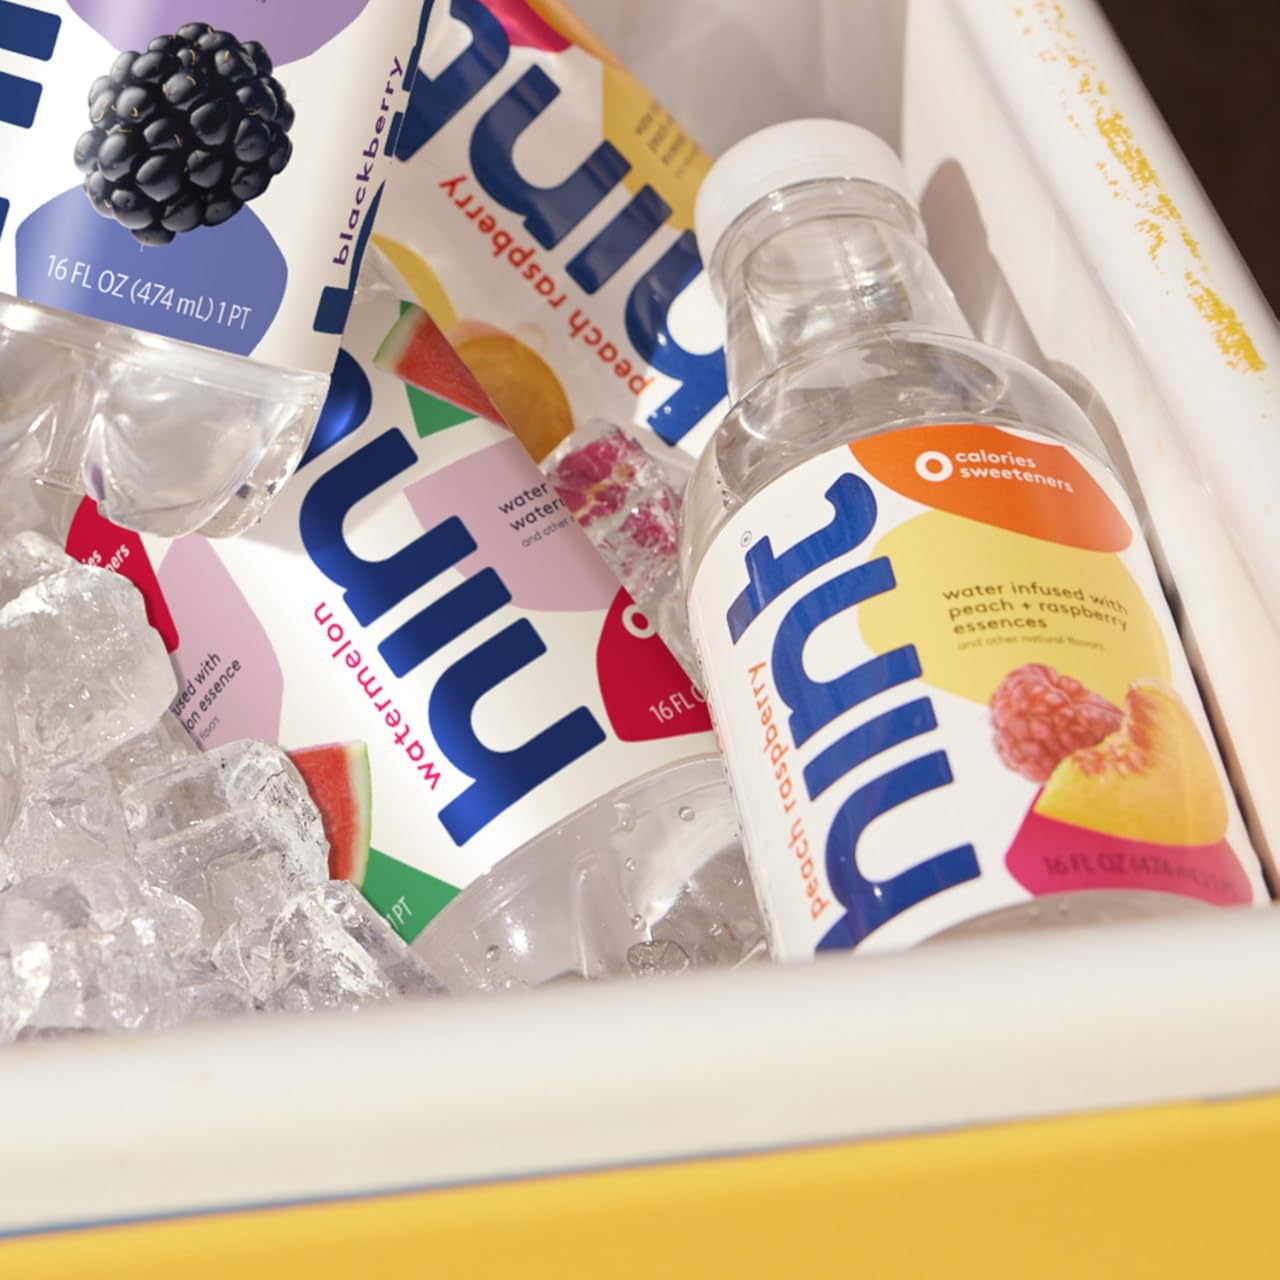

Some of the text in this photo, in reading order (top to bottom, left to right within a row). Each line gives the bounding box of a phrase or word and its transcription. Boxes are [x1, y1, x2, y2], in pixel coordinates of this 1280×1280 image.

[332, 56, 404, 267] blackberry
[47, 255, 253, 330] 16 FL OZ (474 mL) 1 PT
[438, 175, 655, 396] peach raspberry
[915, 449, 1036, 483] 0 calories
[960, 467, 1074, 493] sweeteners
[497, 482, 548, 514] water
[521, 531, 542, 548] and
[942, 581, 1129, 616] water infused with
[948, 598, 1014, 621] peach
[1039, 601, 1128, 632] raspberry
[953, 617, 1049, 635] essences
[170, 680, 197, 716] used
[194, 652, 221, 685] with
[199, 659, 242, 712] essence
[314, 601, 441, 791] watermelon
[649, 700, 674, 724] 16
[669, 691, 695, 714] FL
[726, 472, 982, 956] hint
[747, 661, 830, 920] peach raspberry
[391, 895, 413, 925] PT
